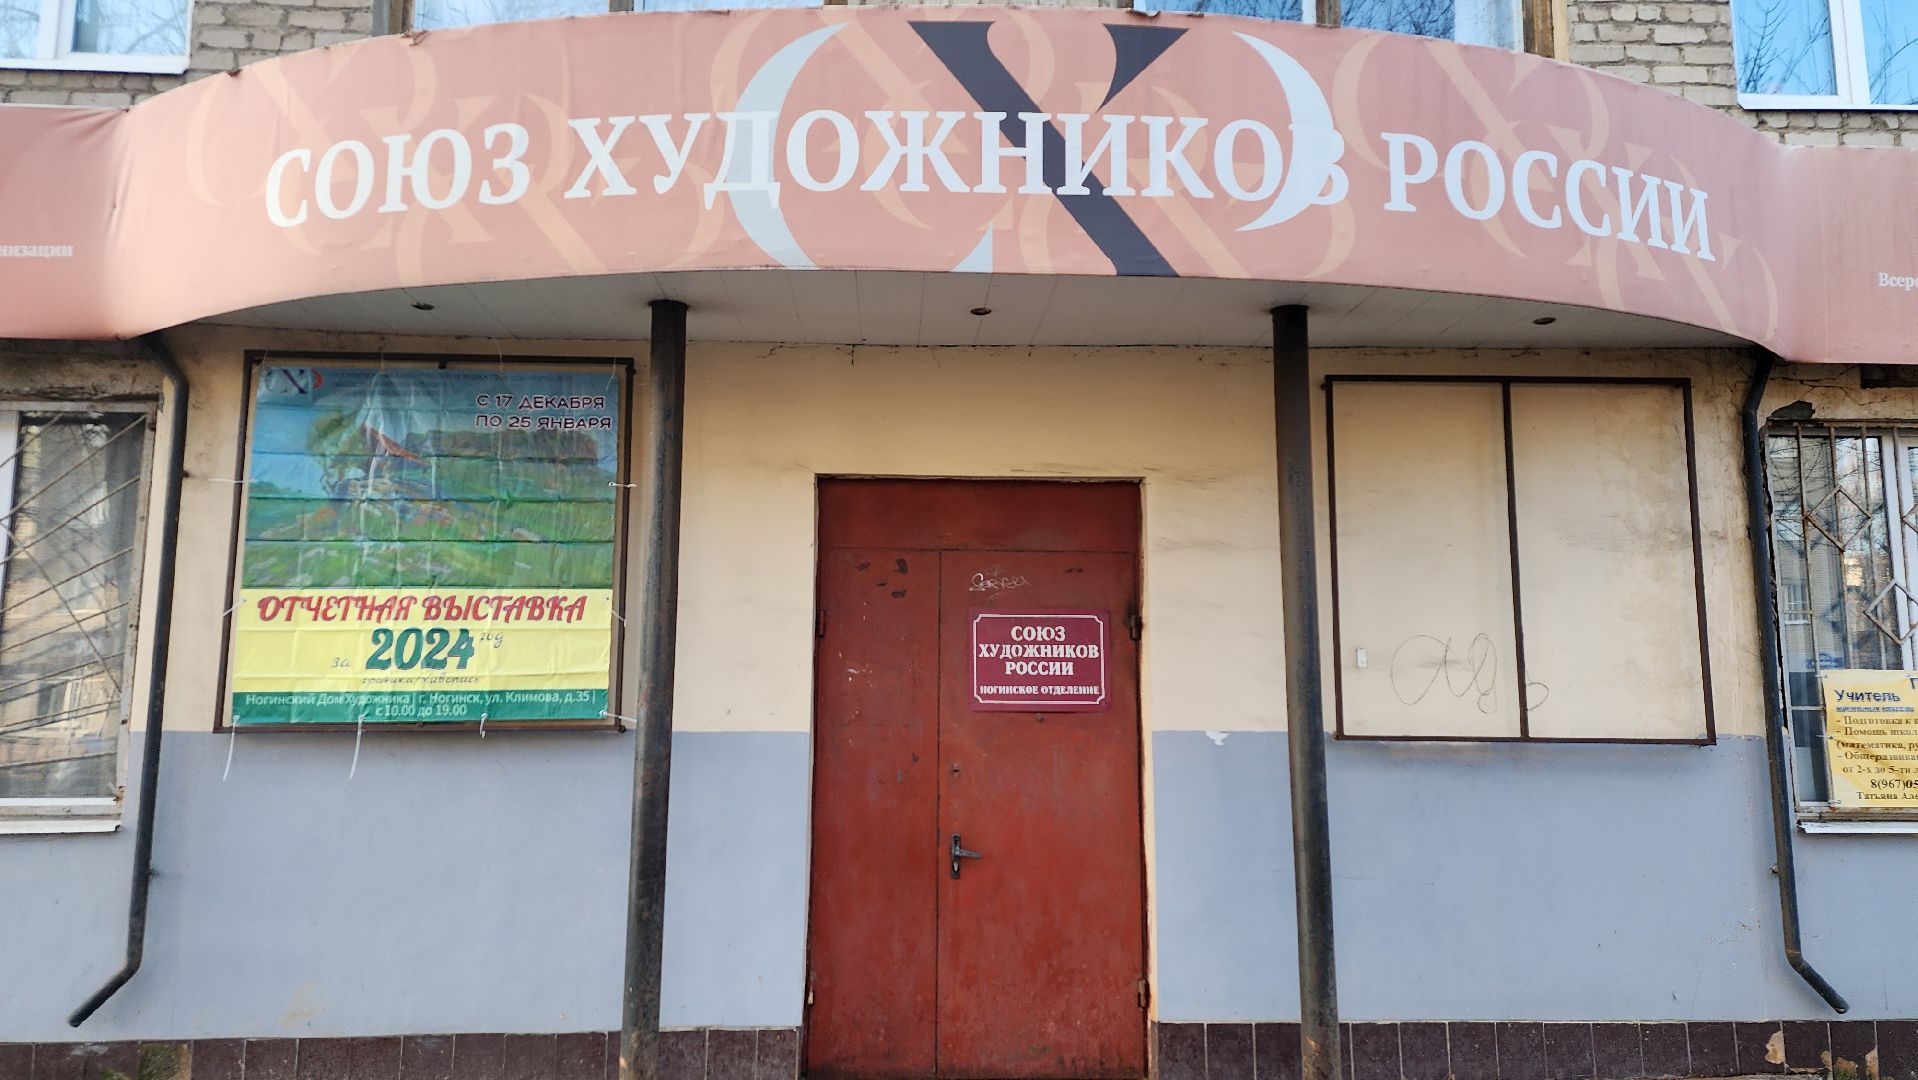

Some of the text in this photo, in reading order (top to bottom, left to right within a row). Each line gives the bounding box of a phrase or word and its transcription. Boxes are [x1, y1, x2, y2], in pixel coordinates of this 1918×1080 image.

[265, 108, 1715, 262] СОЮЗ ХУДОЖНИКОВ РОССИИ
[476, 394, 604, 410] С 17 ДЕКАБРЯ
[475, 415, 612, 430] ПО 25 ЯНВАРЯ
[257, 595, 587, 624] ОТЧЕТНАЯ ВЫСТАВКА
[1010, 626, 1066, 642] СОЮЗ
[365, 627, 475, 670] 2024
[979, 643, 1100, 659] ХУДОЖНИКОВ
[1005, 661, 1074, 676] РОССИИ
[980, 685, 1100, 696] НОГИНСКОЕ ОТДЕЛЕНИЕ
[1834, 689, 1901, 702] Учитель
[384, 705, 415, 716] 10.00
[417, 706, 432, 717] до
[436, 704, 467, 716] 19.00
